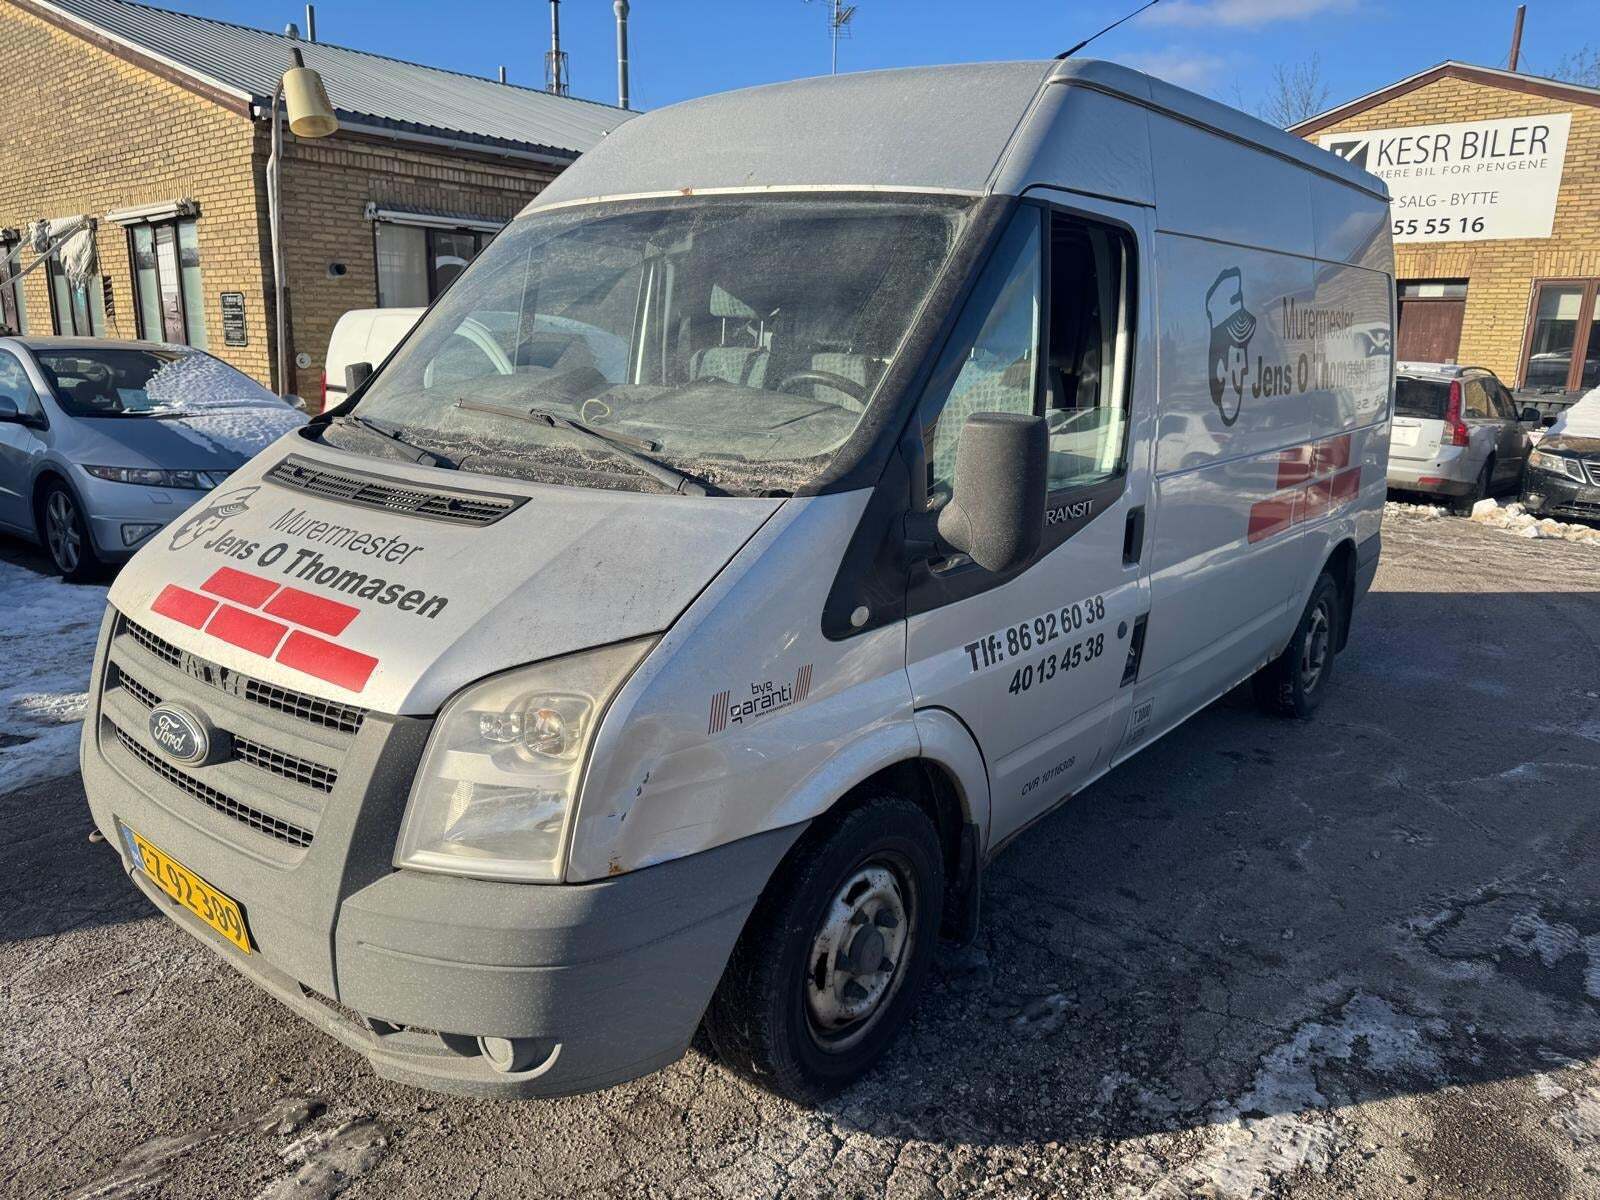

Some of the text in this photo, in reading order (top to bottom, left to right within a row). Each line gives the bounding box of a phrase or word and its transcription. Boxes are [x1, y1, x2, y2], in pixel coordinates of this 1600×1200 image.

[1377, 125, 1550, 167] KESR BILER
[1374, 158, 1549, 179] MERE BIL FOR PENGENE
[1399, 194, 1437, 209] SALG
[1450, 191, 1499, 206] BYTTE
[1392, 216, 1485, 235] 55 55 16
[1283, 297, 1354, 340] Murermester
[1252, 356, 1292, 399] Jens
[1297, 353, 1308, 393] O
[1046, 500, 1094, 526] RANSIT
[269, 508, 424, 565] Murermester
[204, 529, 449, 620] Jens O Thomasen
[964, 595, 1105, 672] Tlf: 86 92 60 38
[1008, 633, 1104, 695] 40 13 45 38
[730, 683, 793, 724] garanti
[751, 681, 773, 695] byg
[154, 714, 184, 752] Ford
[166, 864, 198, 910] 92
